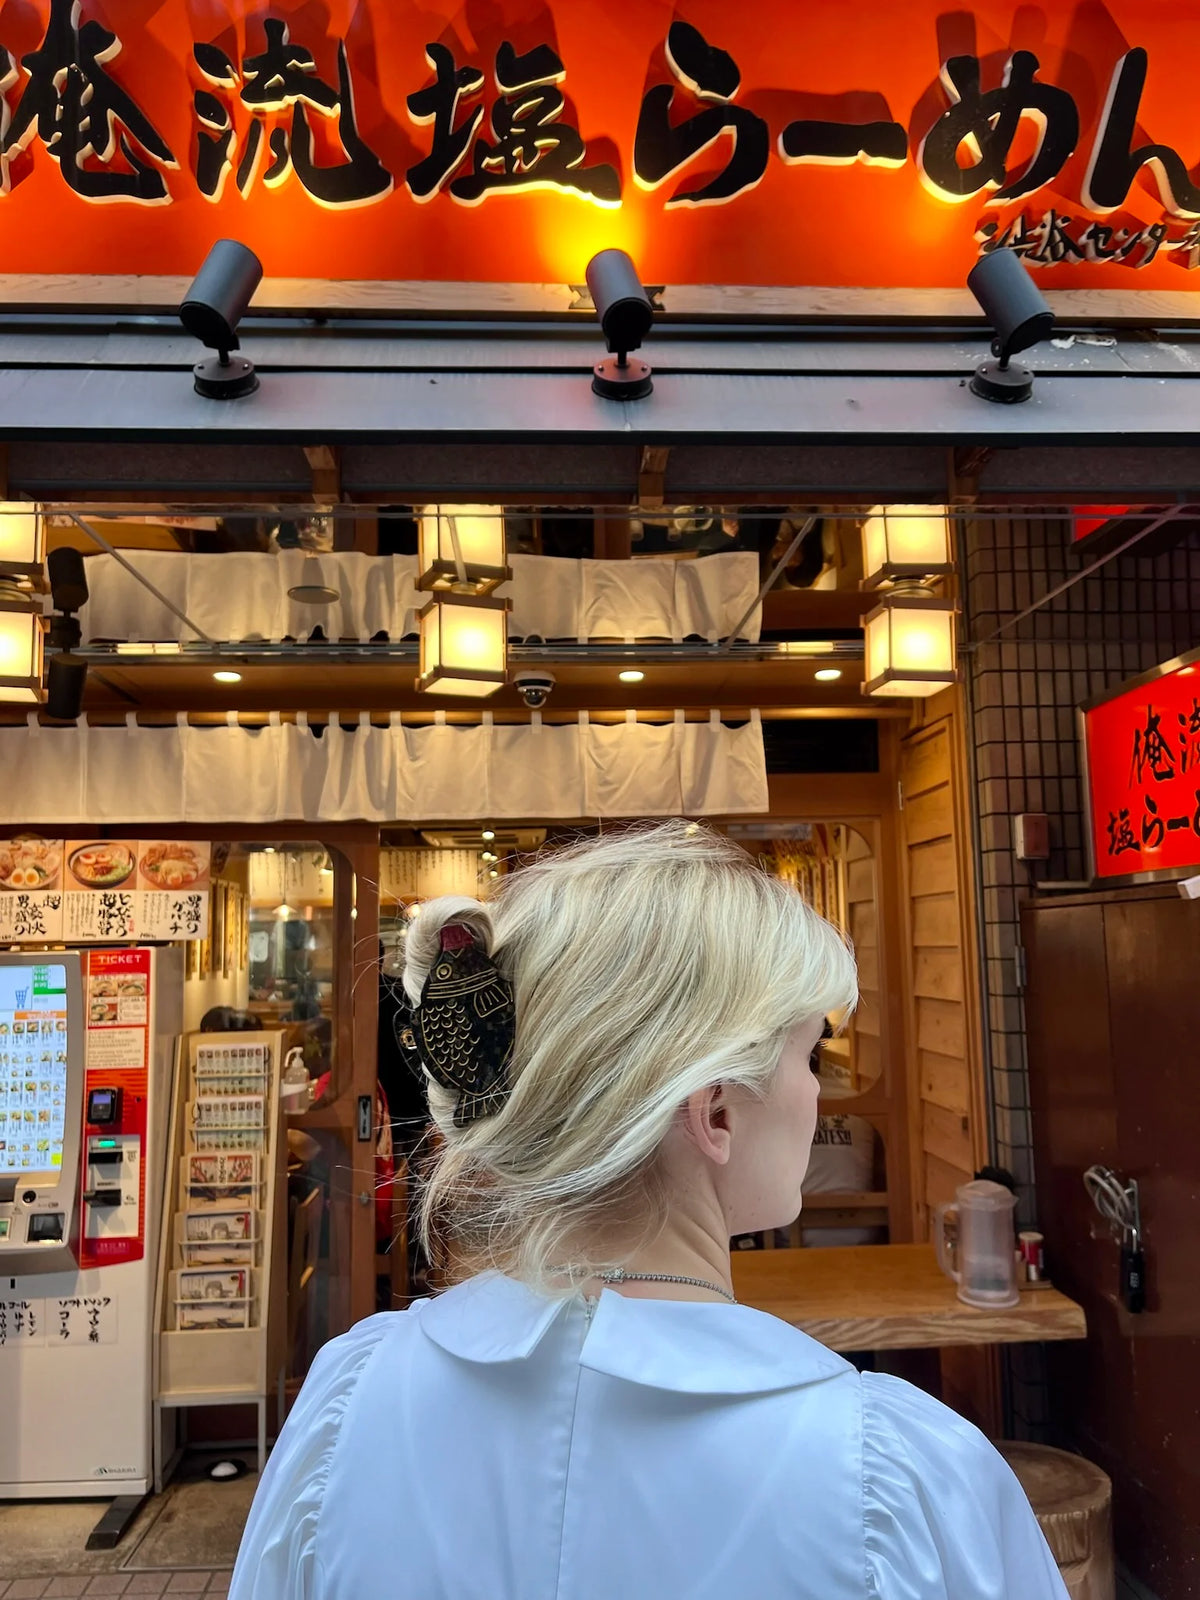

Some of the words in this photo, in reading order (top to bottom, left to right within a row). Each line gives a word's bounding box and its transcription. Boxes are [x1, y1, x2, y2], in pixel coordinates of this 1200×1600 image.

[1107, 789, 1200, 855] 塩らー
[98, 955, 142, 965] TICKET
